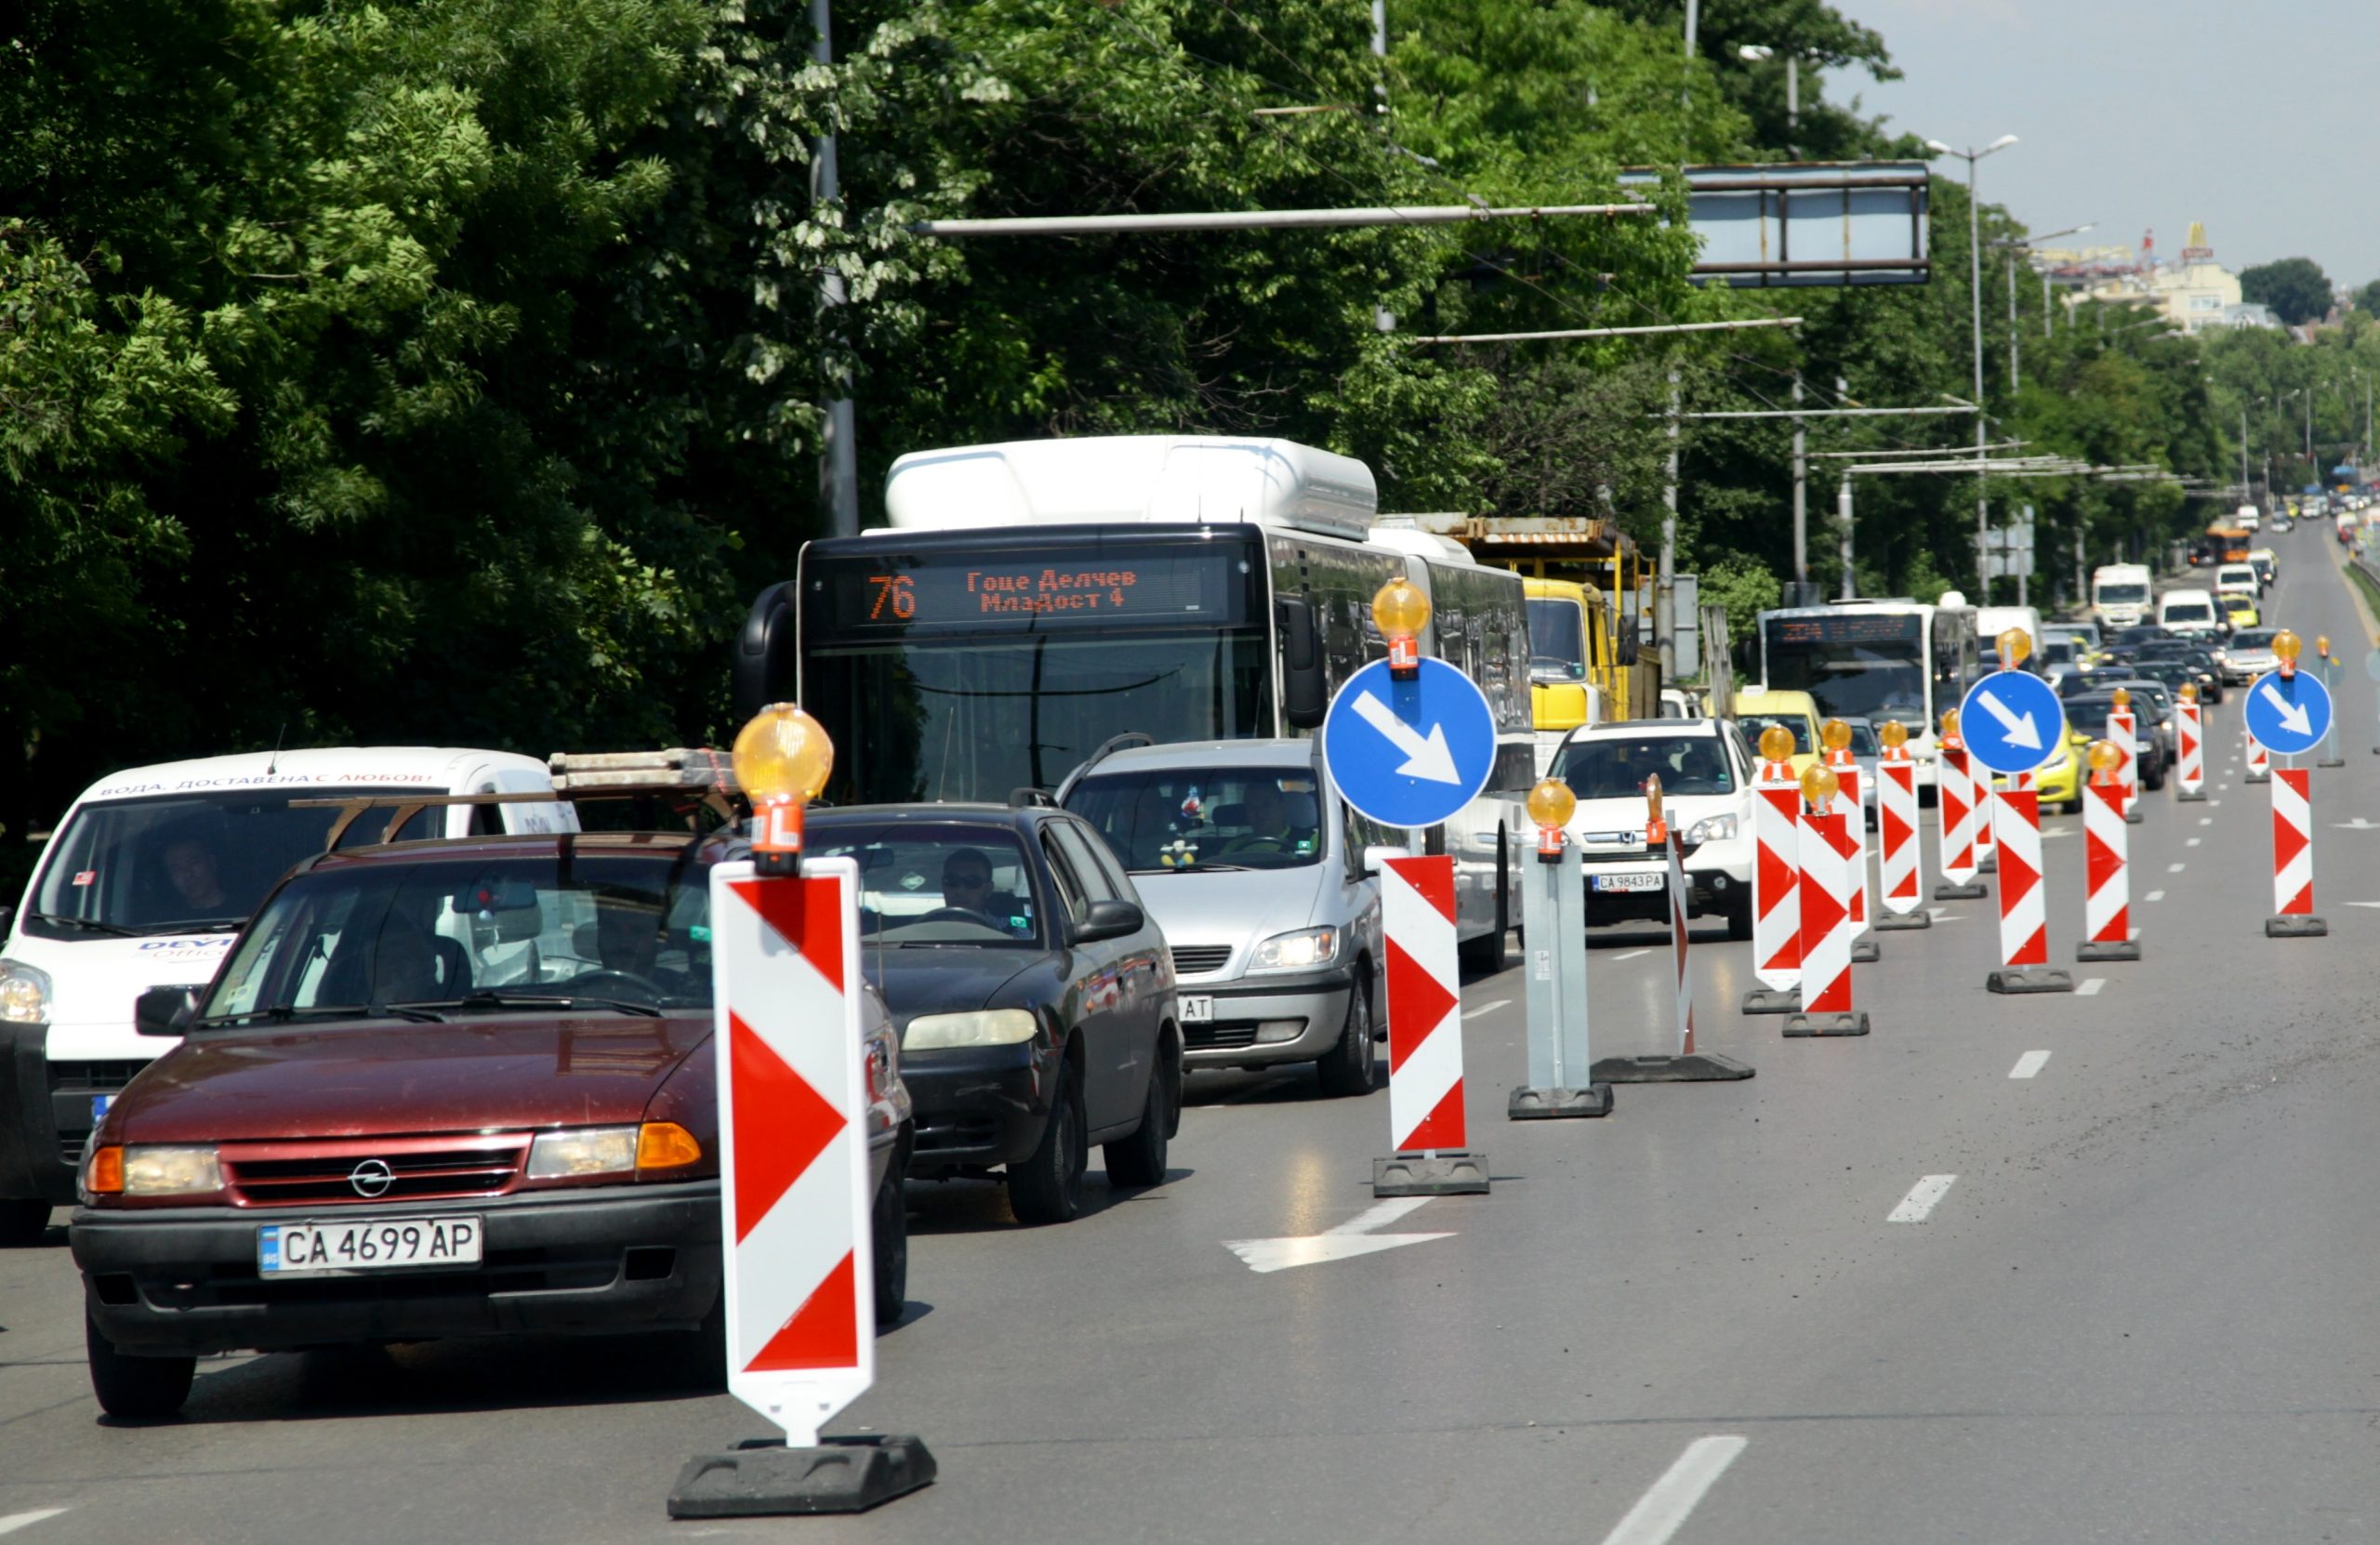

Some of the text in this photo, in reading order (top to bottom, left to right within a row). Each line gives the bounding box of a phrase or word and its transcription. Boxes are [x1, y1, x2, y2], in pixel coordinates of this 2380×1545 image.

[967, 569, 1136, 593] Гоце Делчев
[869, 575, 915, 619] 76
[1110, 587, 1124, 607] 4
[175, 774, 310, 790] ДОСТАВЕНА
[337, 773, 433, 783] ЛЮБОВ!
[1185, 998, 1209, 1018] AT
[285, 1230, 329, 1265] CA
[337, 1226, 420, 1262] 4699
[429, 1223, 473, 1259] AP
